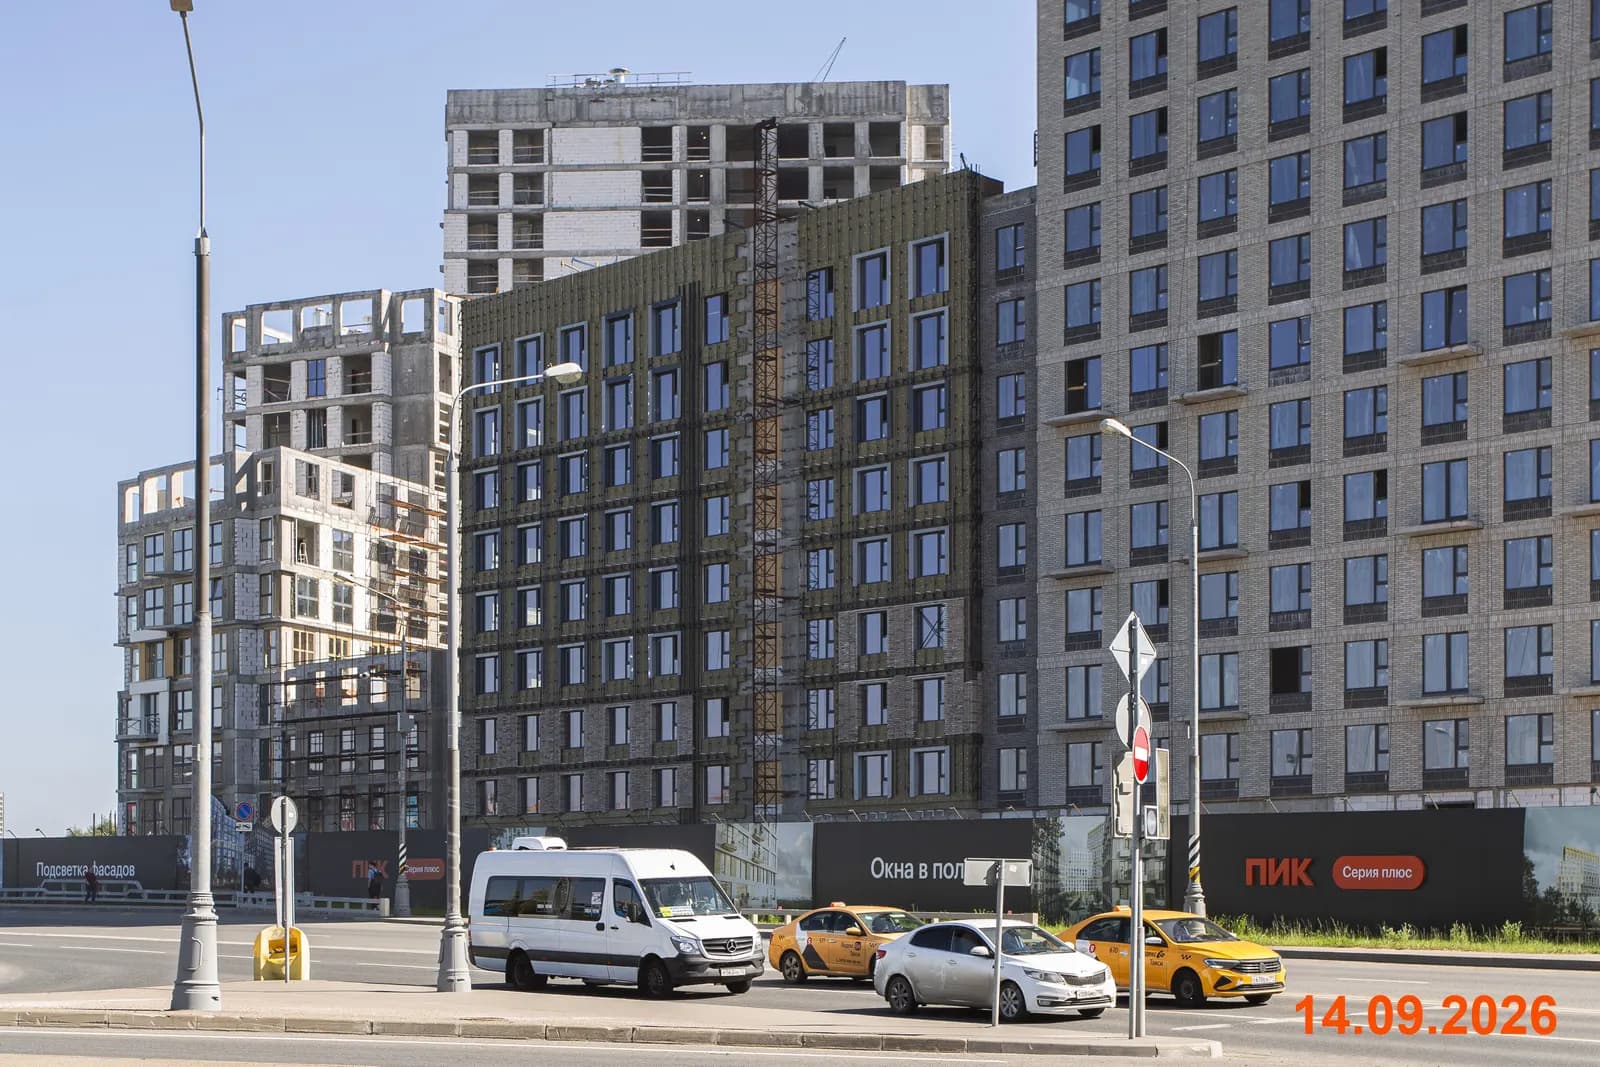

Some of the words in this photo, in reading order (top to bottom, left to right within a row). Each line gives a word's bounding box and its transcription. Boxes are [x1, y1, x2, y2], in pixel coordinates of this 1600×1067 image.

[36, 862, 88, 878] Подсветка
[870, 856, 914, 879] Окна
[918, 862, 928, 879] в
[1245, 857, 1314, 886] ПИК
[1342, 865, 1379, 880] Серия
[1381, 868, 1413, 879] плюс
